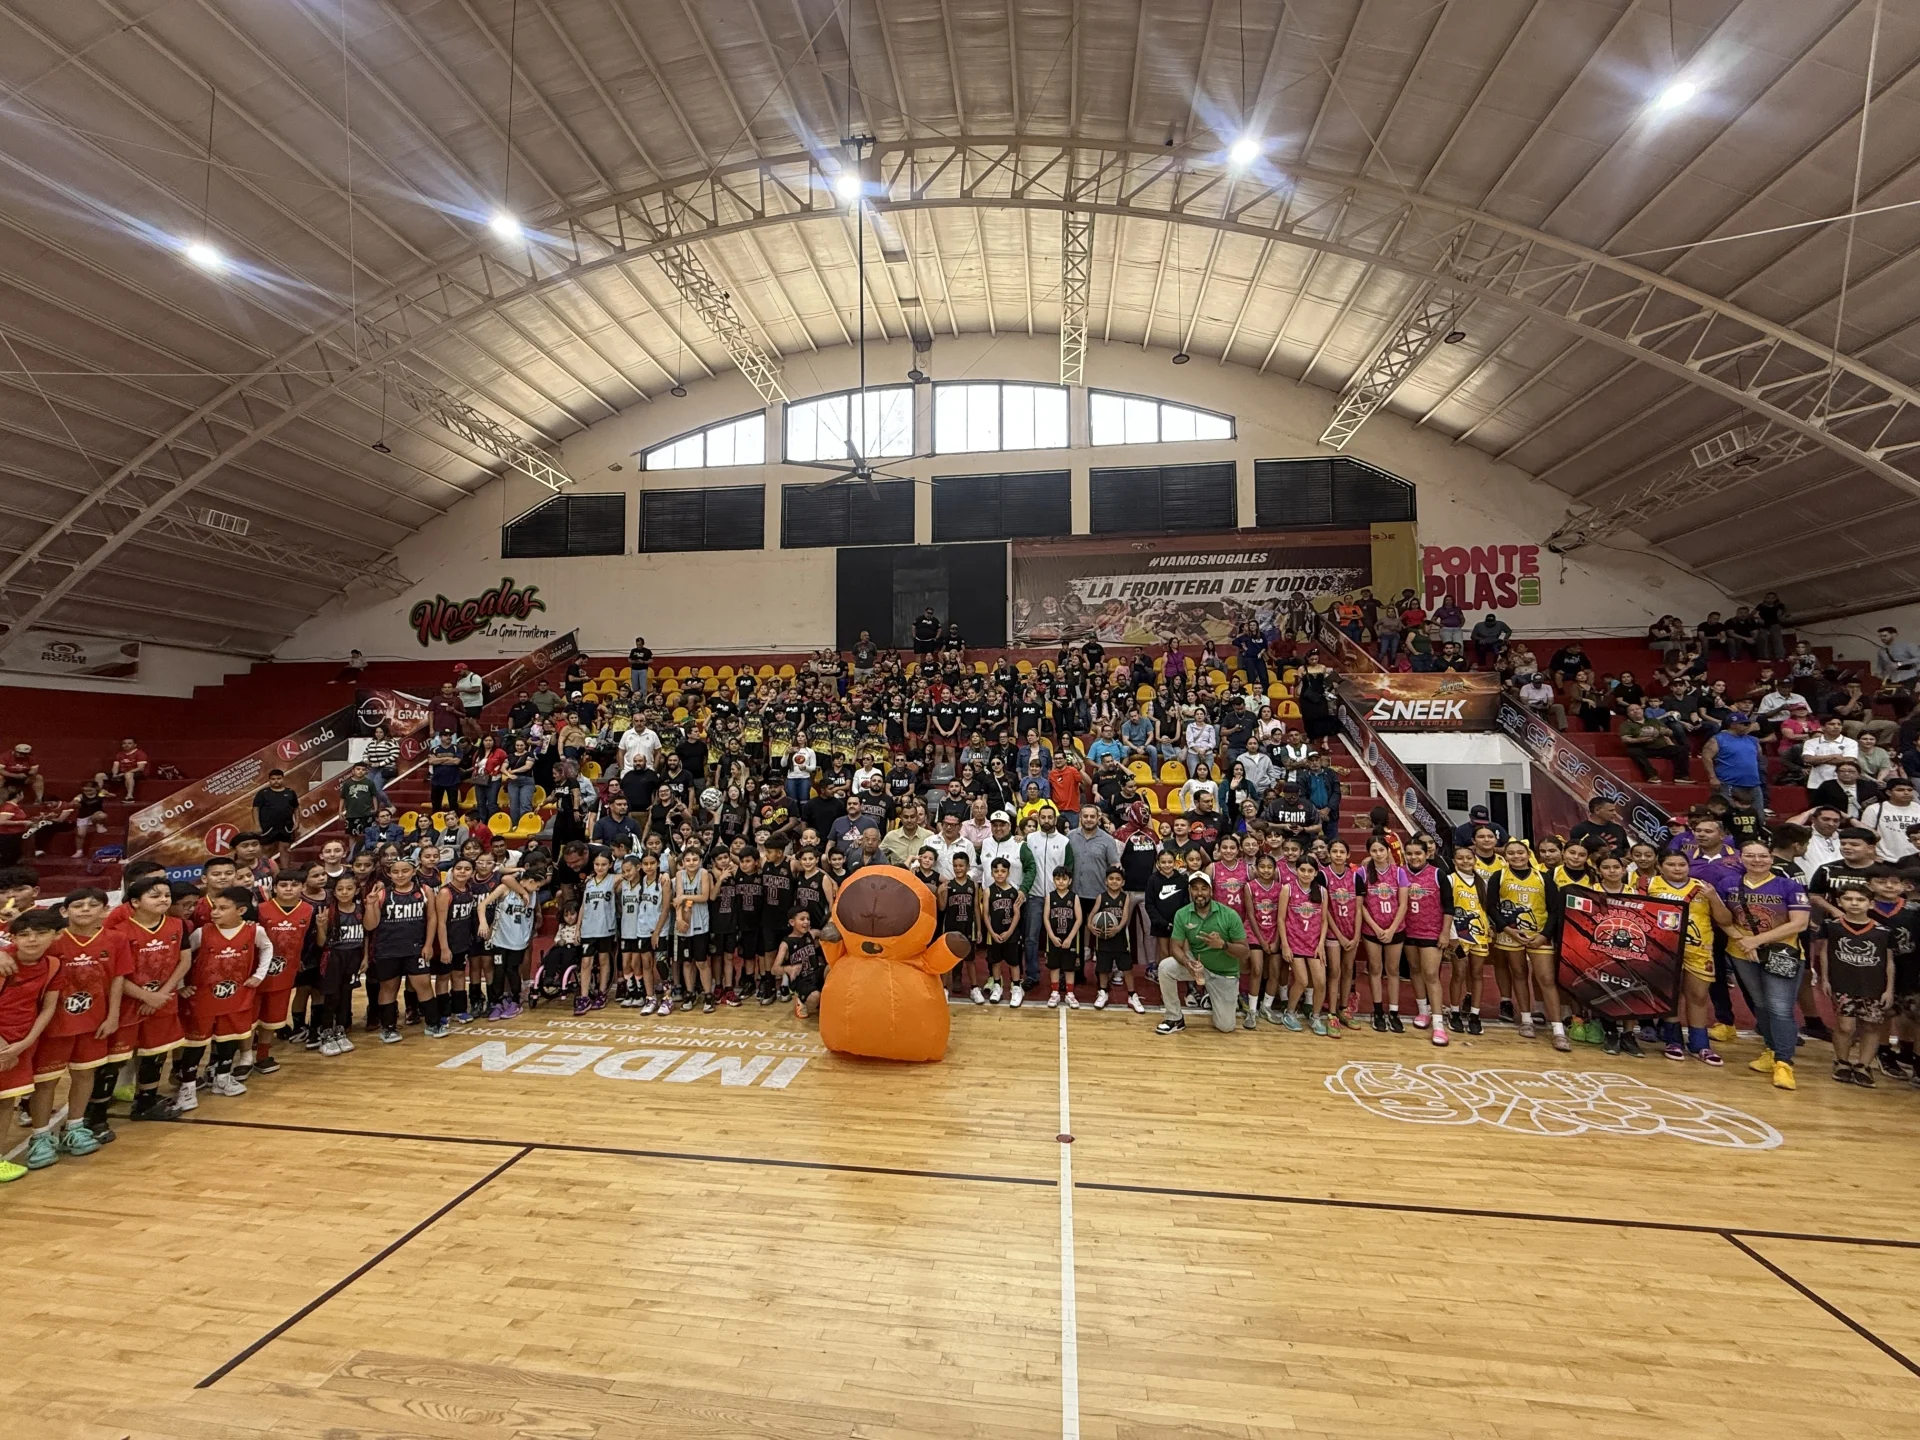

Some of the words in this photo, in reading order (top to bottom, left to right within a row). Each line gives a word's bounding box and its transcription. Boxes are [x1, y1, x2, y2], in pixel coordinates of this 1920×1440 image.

[1149, 552, 1268, 567] #VAMOSNOGALES
[1423, 545, 1540, 575] PONTE
[1087, 582, 1113, 598] LA
[1119, 577, 1224, 598] FRONTERA
[1229, 577, 1259, 593] DE
[1265, 575, 1334, 593] TODOS
[1424, 572, 1518, 611] PILAS
[411, 577, 546, 647] Nogales
[486, 623, 497, 637] La
[499, 624, 517, 642] Gran
[513, 623, 549, 639] Frontera
[357, 708, 389, 716] NISSAN
[1368, 697, 1468, 721] SNEEK
[139, 798, 195, 832] corona
[1278, 810, 1306, 823] FENIX
[1883, 814, 1920, 824] RAVEN
[1133, 843, 1154, 852] IMDEN
[1161, 884, 1177, 893] NIKE
[1227, 893, 1242, 905] 24
[1469, 900, 1477, 909] 9
[1517, 893, 1529, 903] 18
[1728, 893, 1783, 905] MIERAS
[386, 901, 424, 920] FENIX
[593, 901, 600, 911] 7
[1338, 905, 1349, 917] 12
[1379, 901, 1392, 914] 10
[1411, 901, 1420, 914] 9
[1302, 919, 1310, 932] 7
[581, 943, 590, 953] 7
[1840, 952, 1877, 966] RAVENS
[1600, 971, 1632, 988] BCS
[450, 1026, 557, 1039] DEPORTE
[547, 1020, 646, 1032] SONORA
[652, 1024, 769, 1038] NOGALES,
[562, 1031, 609, 1042] DEL
[616, 1032, 750, 1050] MUNICIPAL
[773, 1031, 809, 1041] DE
[435, 1040, 811, 1089] IMDEN
